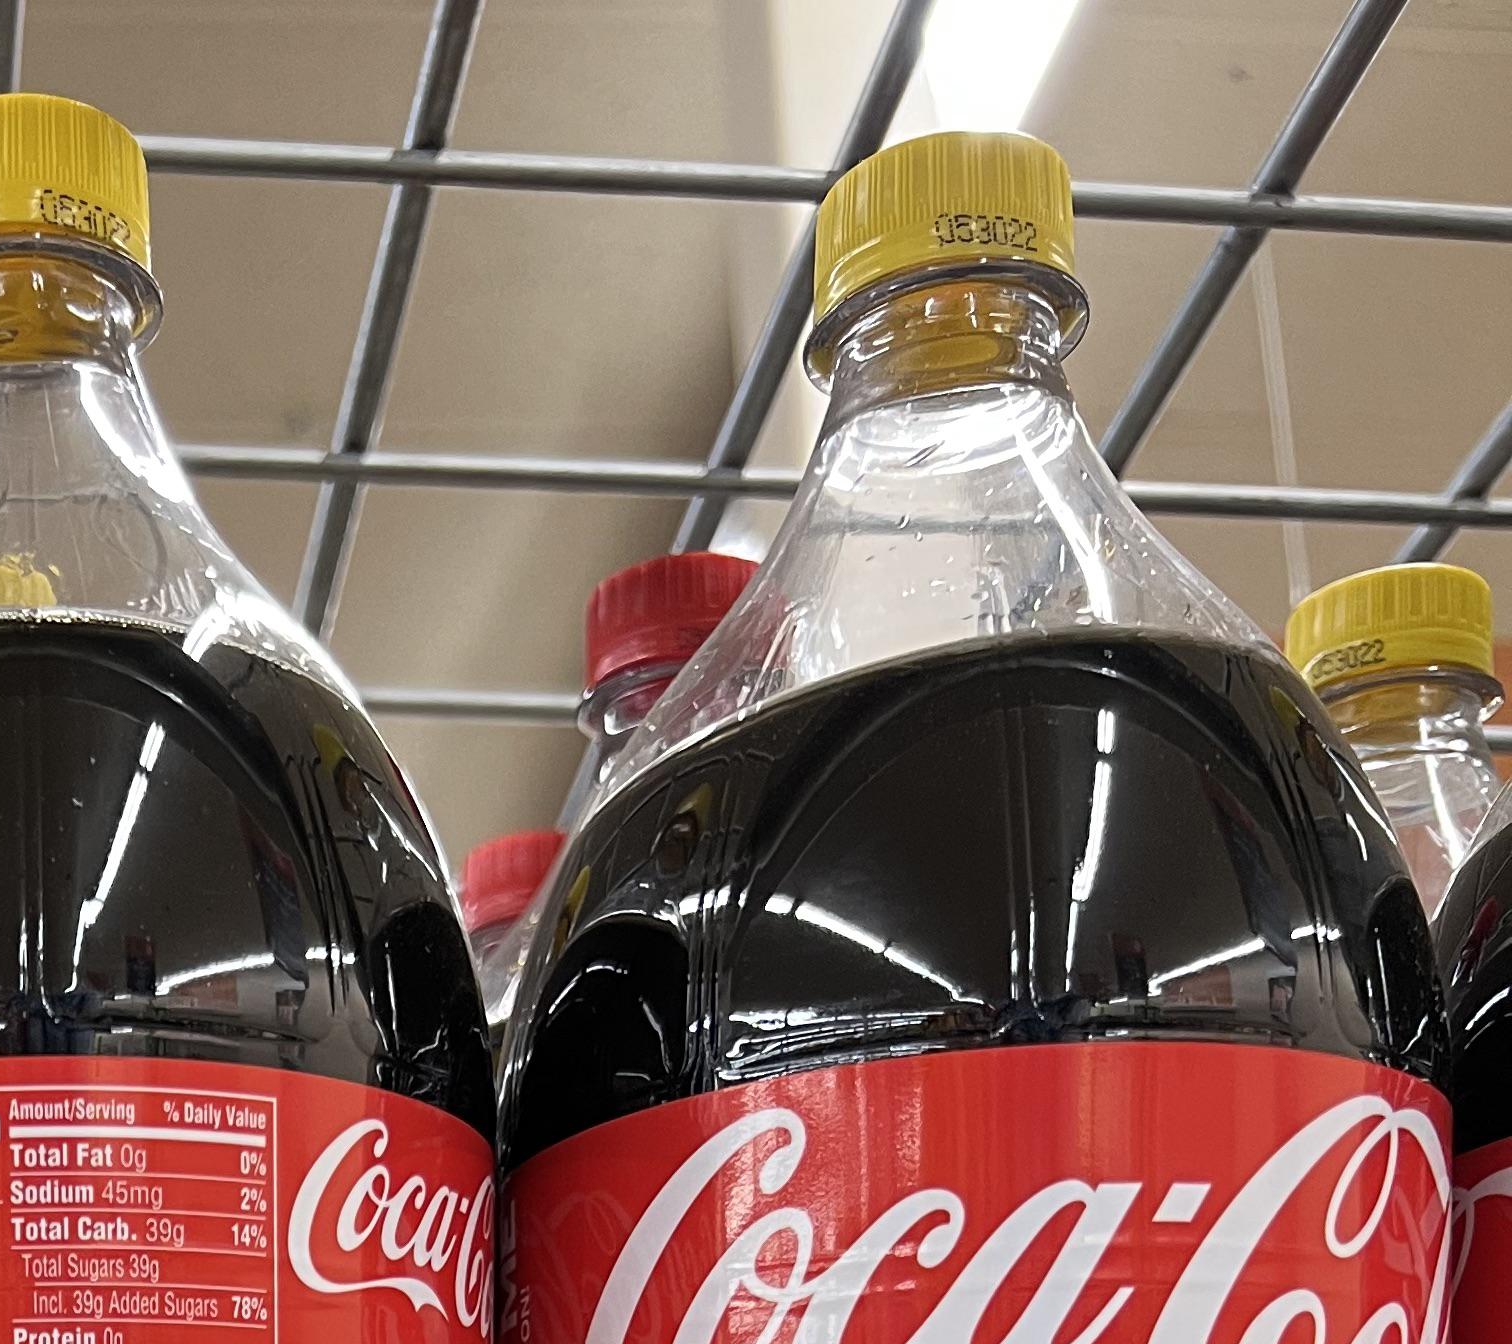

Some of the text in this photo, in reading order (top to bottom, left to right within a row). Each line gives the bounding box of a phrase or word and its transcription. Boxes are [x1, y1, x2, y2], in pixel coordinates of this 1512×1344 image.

[935, 212, 1038, 252] 053022
[8, 1097, 267, 1130] Amount/Serving Daily Value
[9, 1142, 268, 1177] Total Fat 0g 0%
[9, 1179, 268, 1213] Sodium 45mg 2%
[10, 1216, 268, 1249] Total Carb. 39g 14%
[21, 1252, 160, 1284] Total Sugars 39g
[33, 1289, 268, 1322] Incl. 39g Added Sugars 78%
